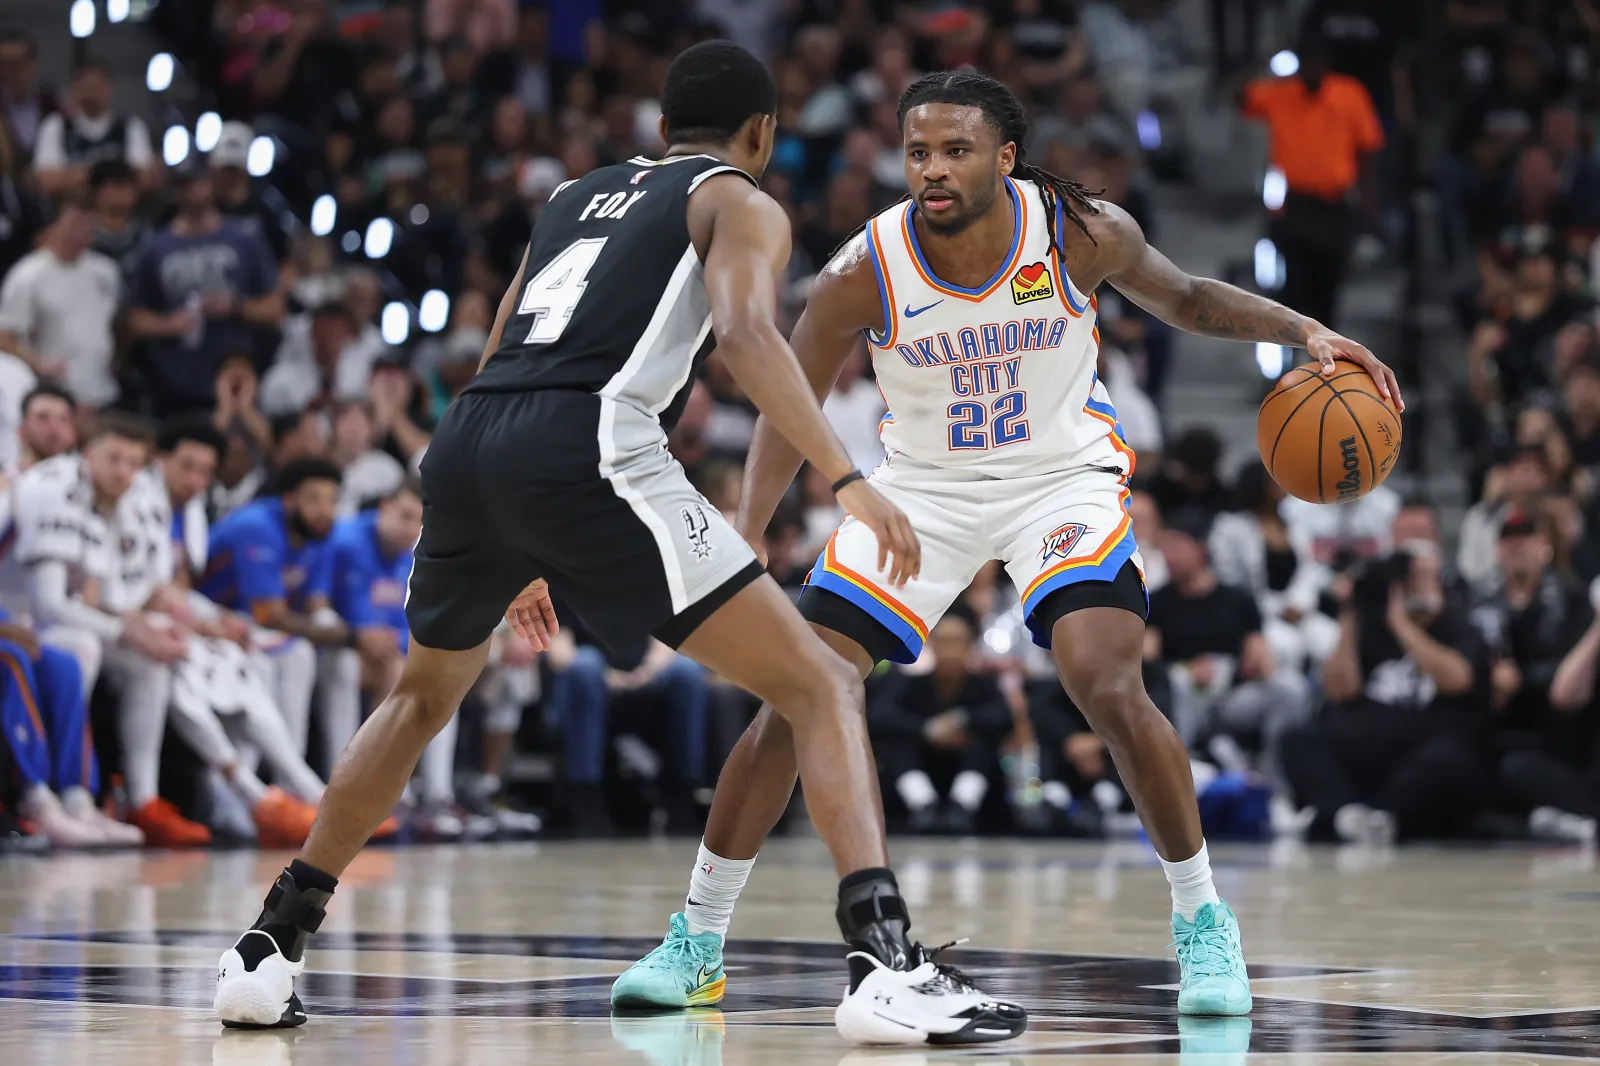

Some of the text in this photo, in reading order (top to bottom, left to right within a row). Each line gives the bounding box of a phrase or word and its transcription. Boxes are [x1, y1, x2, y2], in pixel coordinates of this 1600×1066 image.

[578, 190, 647, 221] FOX
[517, 236, 609, 344] 4
[895, 317, 1068, 368] OKLAHOMA
[950, 356, 1022, 397] CITY
[947, 390, 1031, 451] 22
[1043, 527, 1077, 559] OKC
